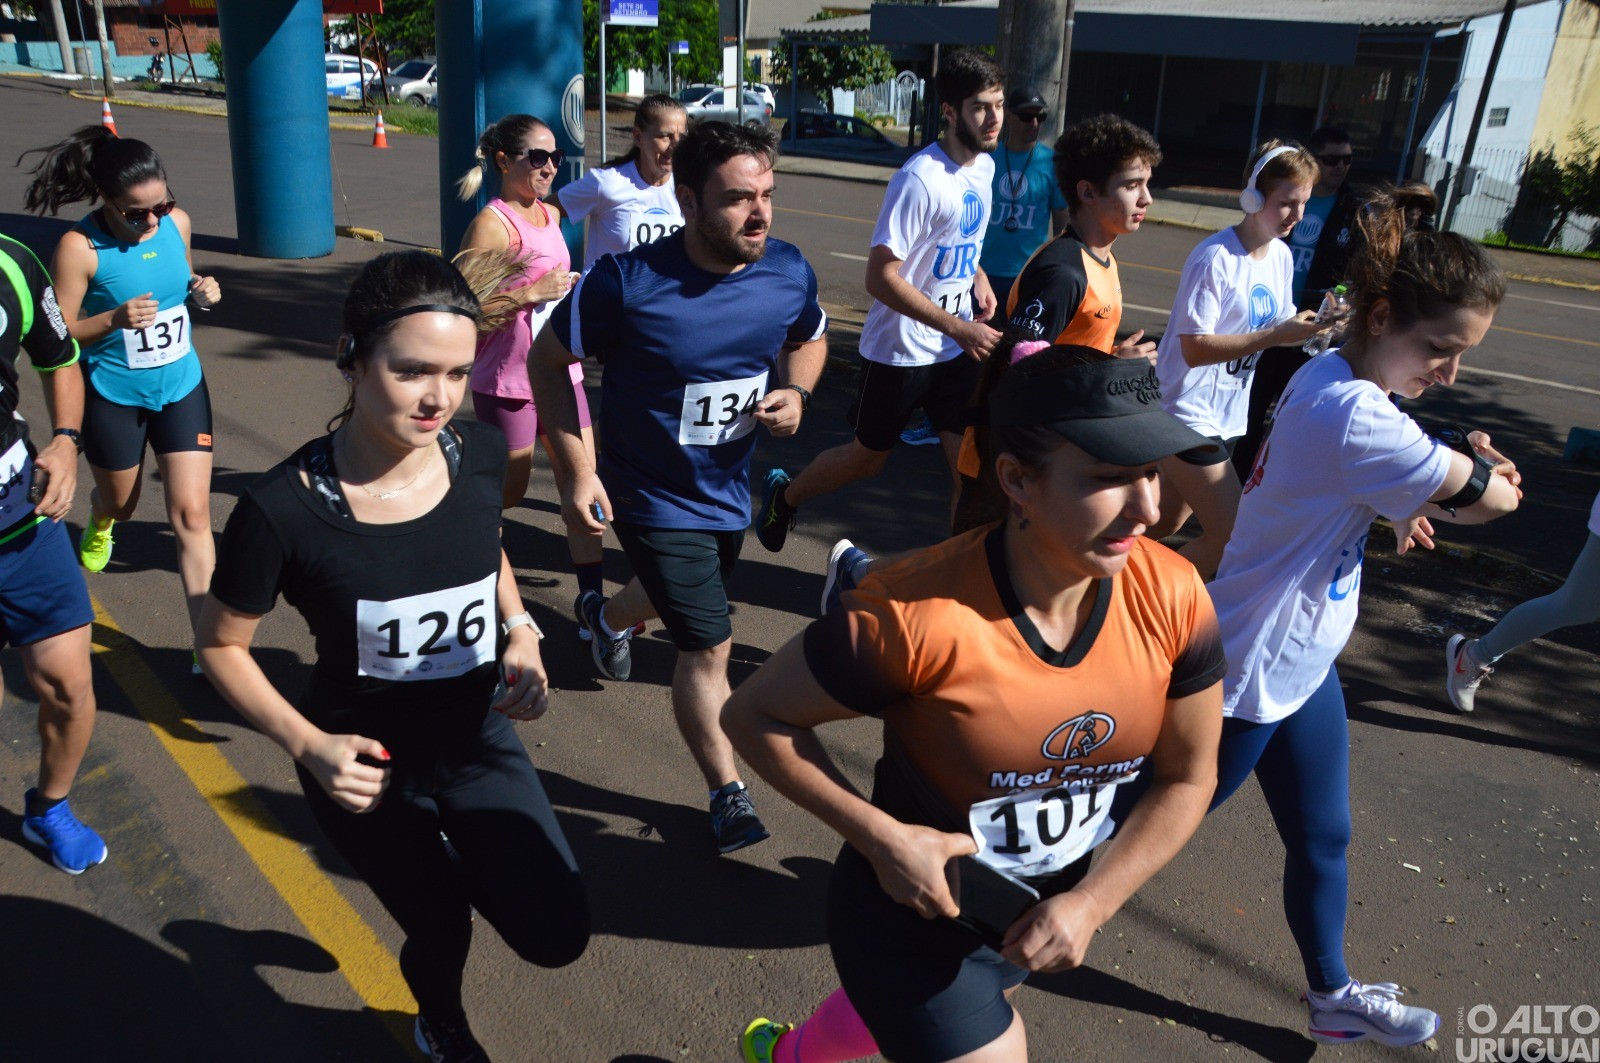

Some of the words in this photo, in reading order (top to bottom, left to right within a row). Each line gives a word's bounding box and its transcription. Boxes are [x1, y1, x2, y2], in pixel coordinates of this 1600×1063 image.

[142, 252, 157, 260] FILA
[932, 239, 984, 280] UR
[134, 314, 184, 353] 137
[1010, 316, 1045, 335] ALESSI
[693, 387, 759, 427] 134
[377, 599, 486, 659] 126
[990, 767, 1053, 788] Med
[990, 786, 1101, 855] 101
